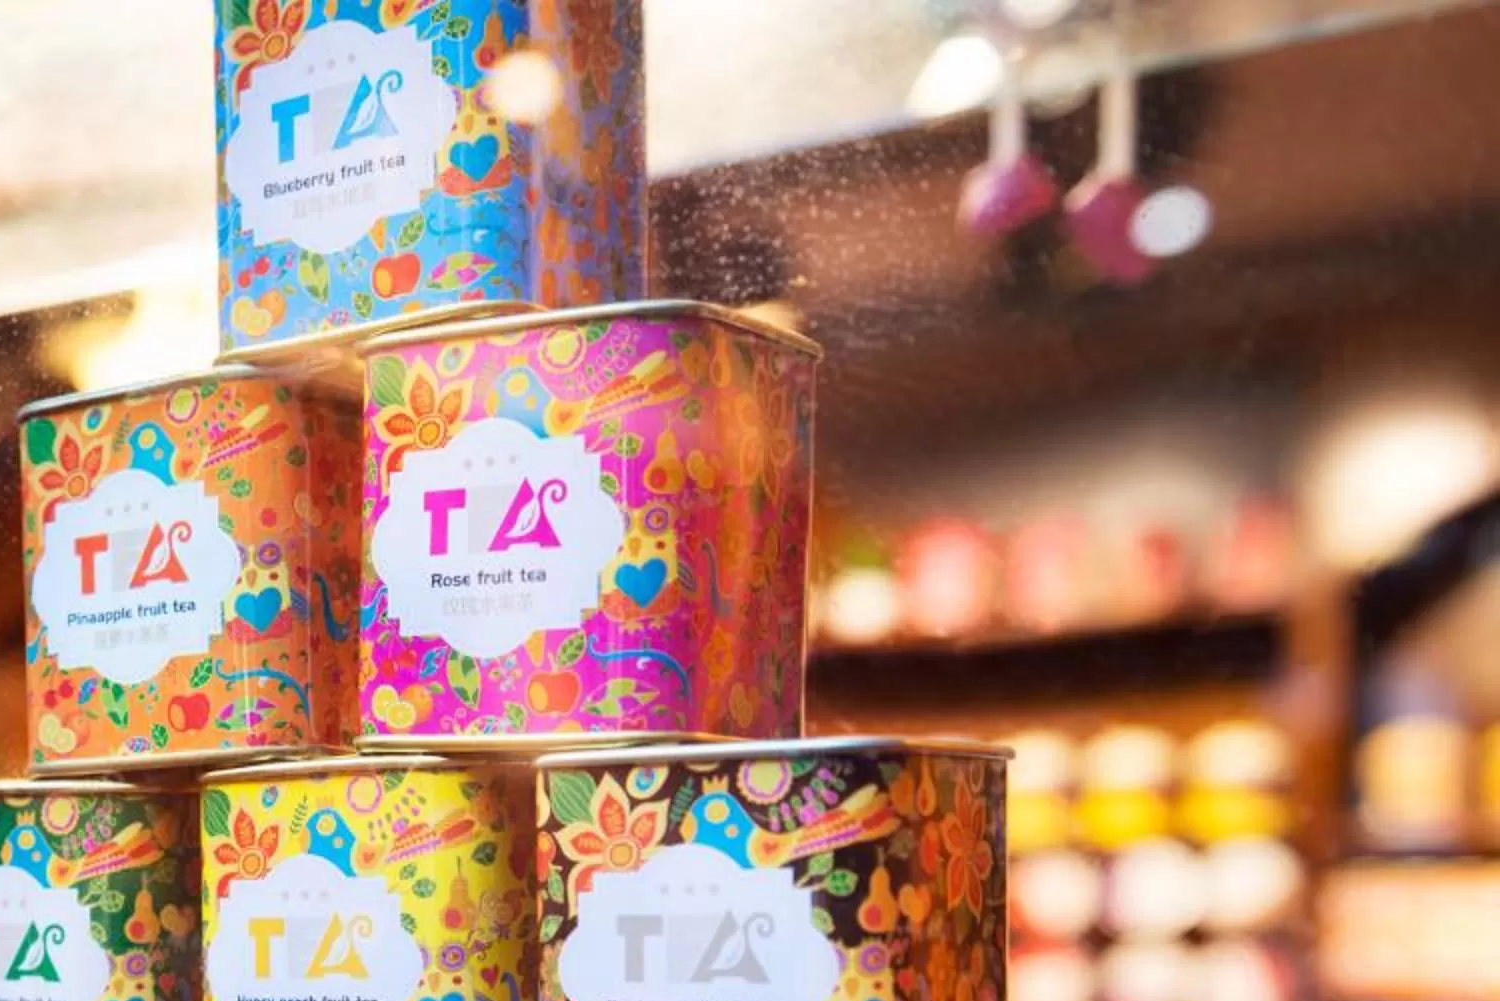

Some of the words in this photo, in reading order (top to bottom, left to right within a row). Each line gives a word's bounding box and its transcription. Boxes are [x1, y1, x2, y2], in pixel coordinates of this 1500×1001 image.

[263, 169, 335, 199] Blueberry
[340, 158, 373, 179] fruit
[378, 154, 405, 171] tea
[431, 573, 470, 588] Rose
[477, 570, 513, 586] fruit
[520, 568, 547, 583] tea
[137, 601, 168, 618] fruit
[173, 599, 197, 614] tea
